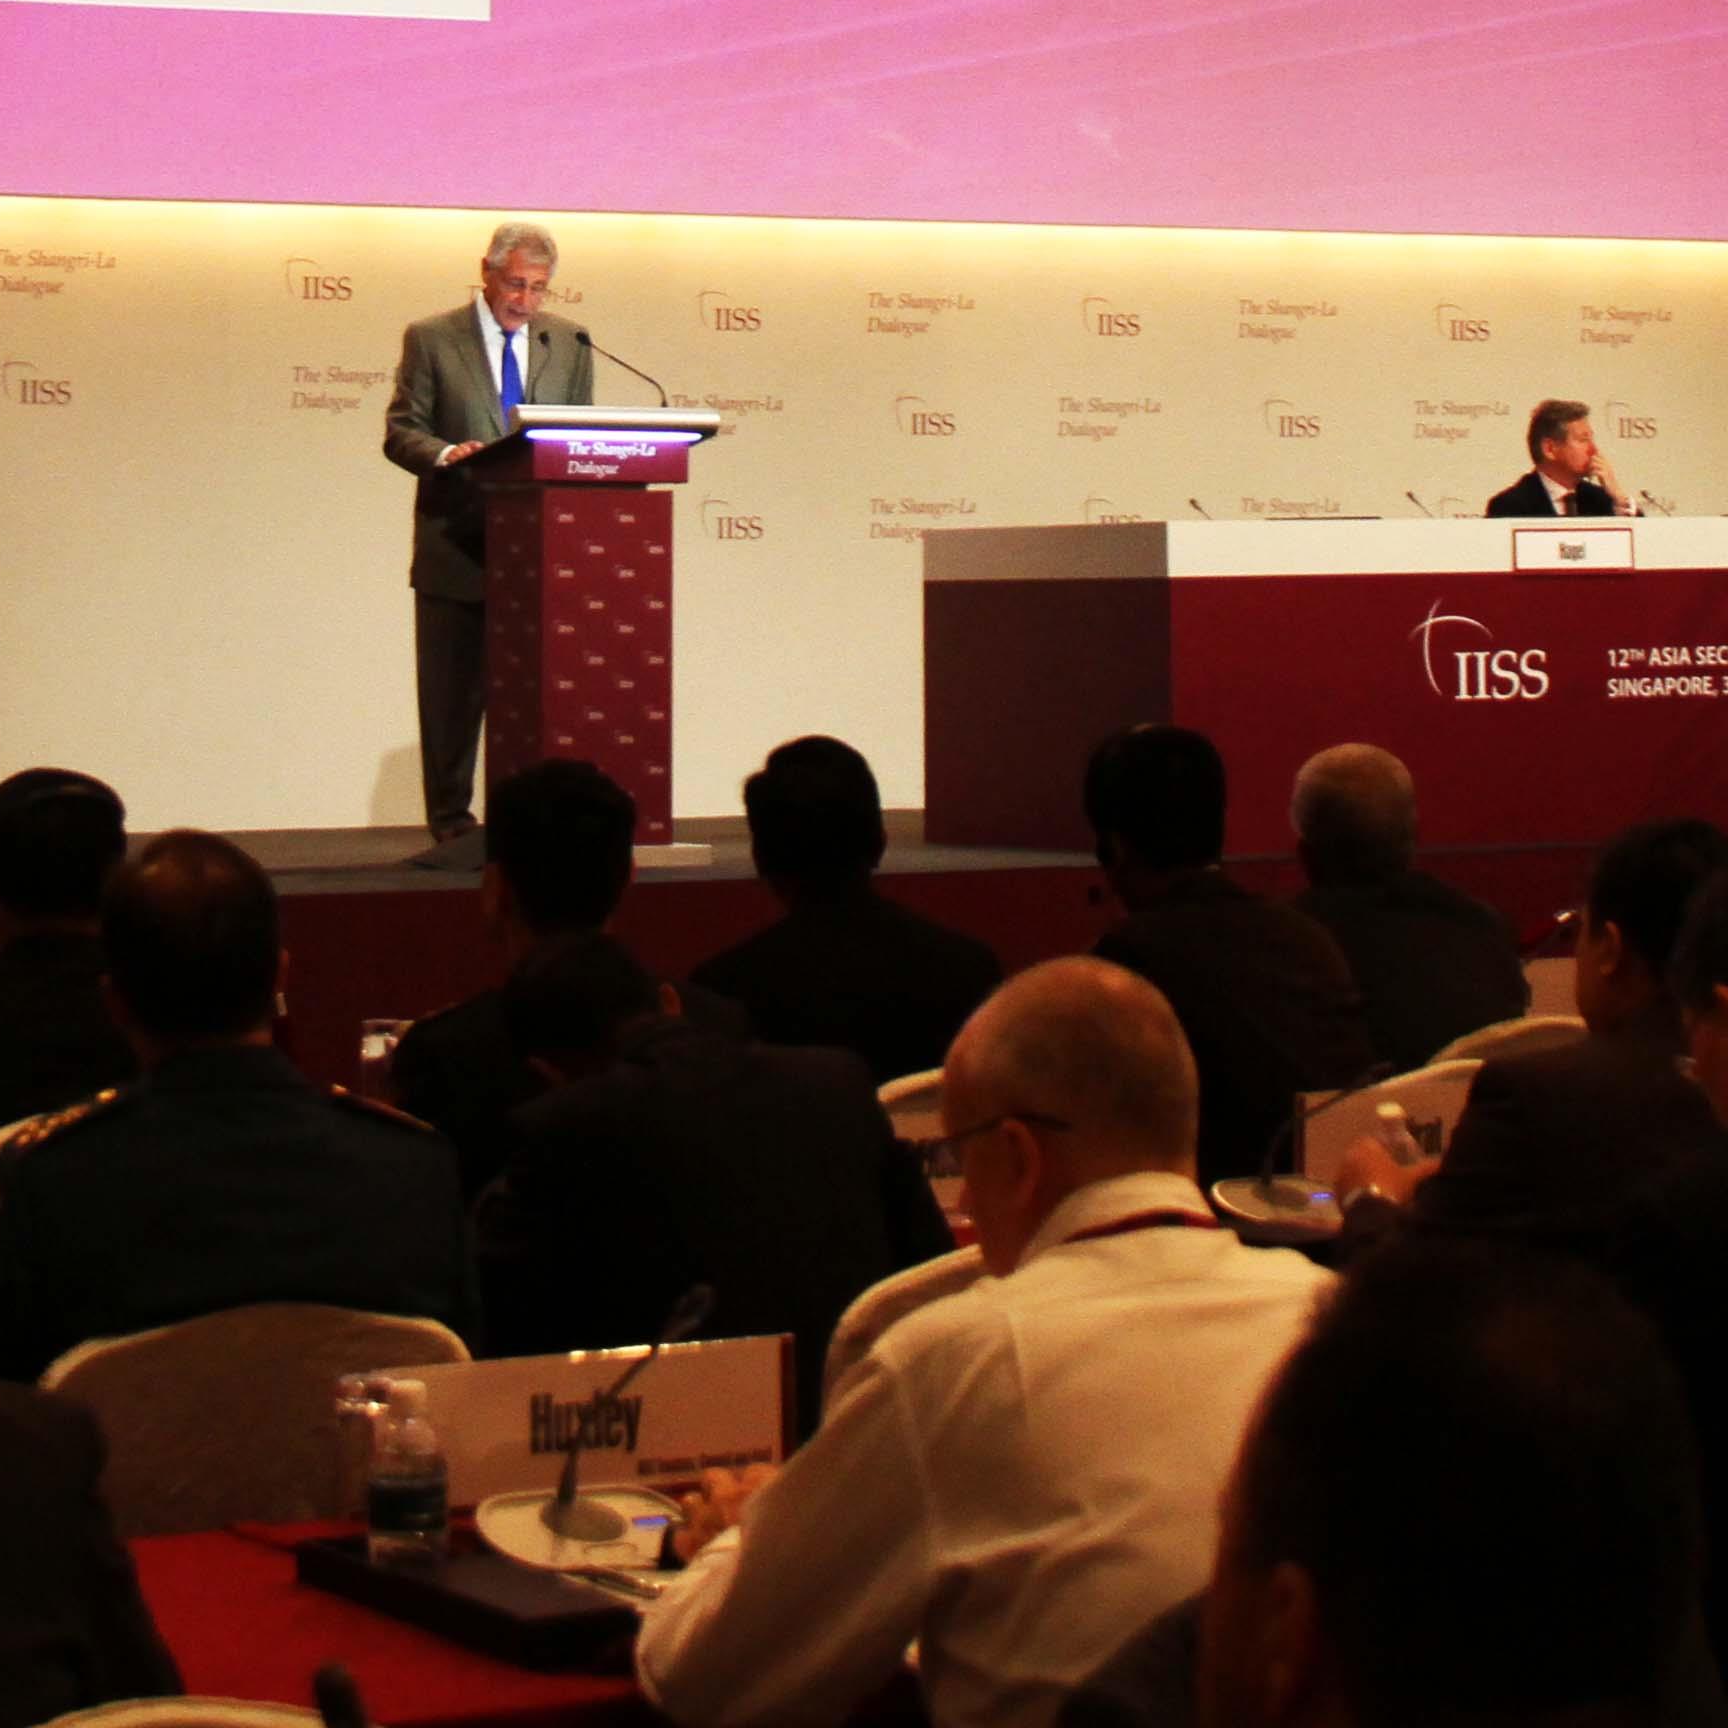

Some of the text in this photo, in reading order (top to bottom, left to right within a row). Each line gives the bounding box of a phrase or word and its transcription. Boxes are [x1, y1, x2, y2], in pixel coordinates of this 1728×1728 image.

[303, 276, 353, 301] IISS
[715, 307, 762, 331] IISS
[1098, 314, 1141, 337] IISS
[1450, 319, 1490, 342] IISS
[20, 379, 71, 405] IISS
[911, 412, 956, 436] IISS
[1279, 415, 1321, 438] IISS
[1618, 417, 1657, 439] IISS
[717, 516, 764, 540] IISS
[1648, 647, 1692, 667] ASIA
[1454, 649, 1549, 701] IISS
[1607, 677, 1718, 698] SINGAPORE,
